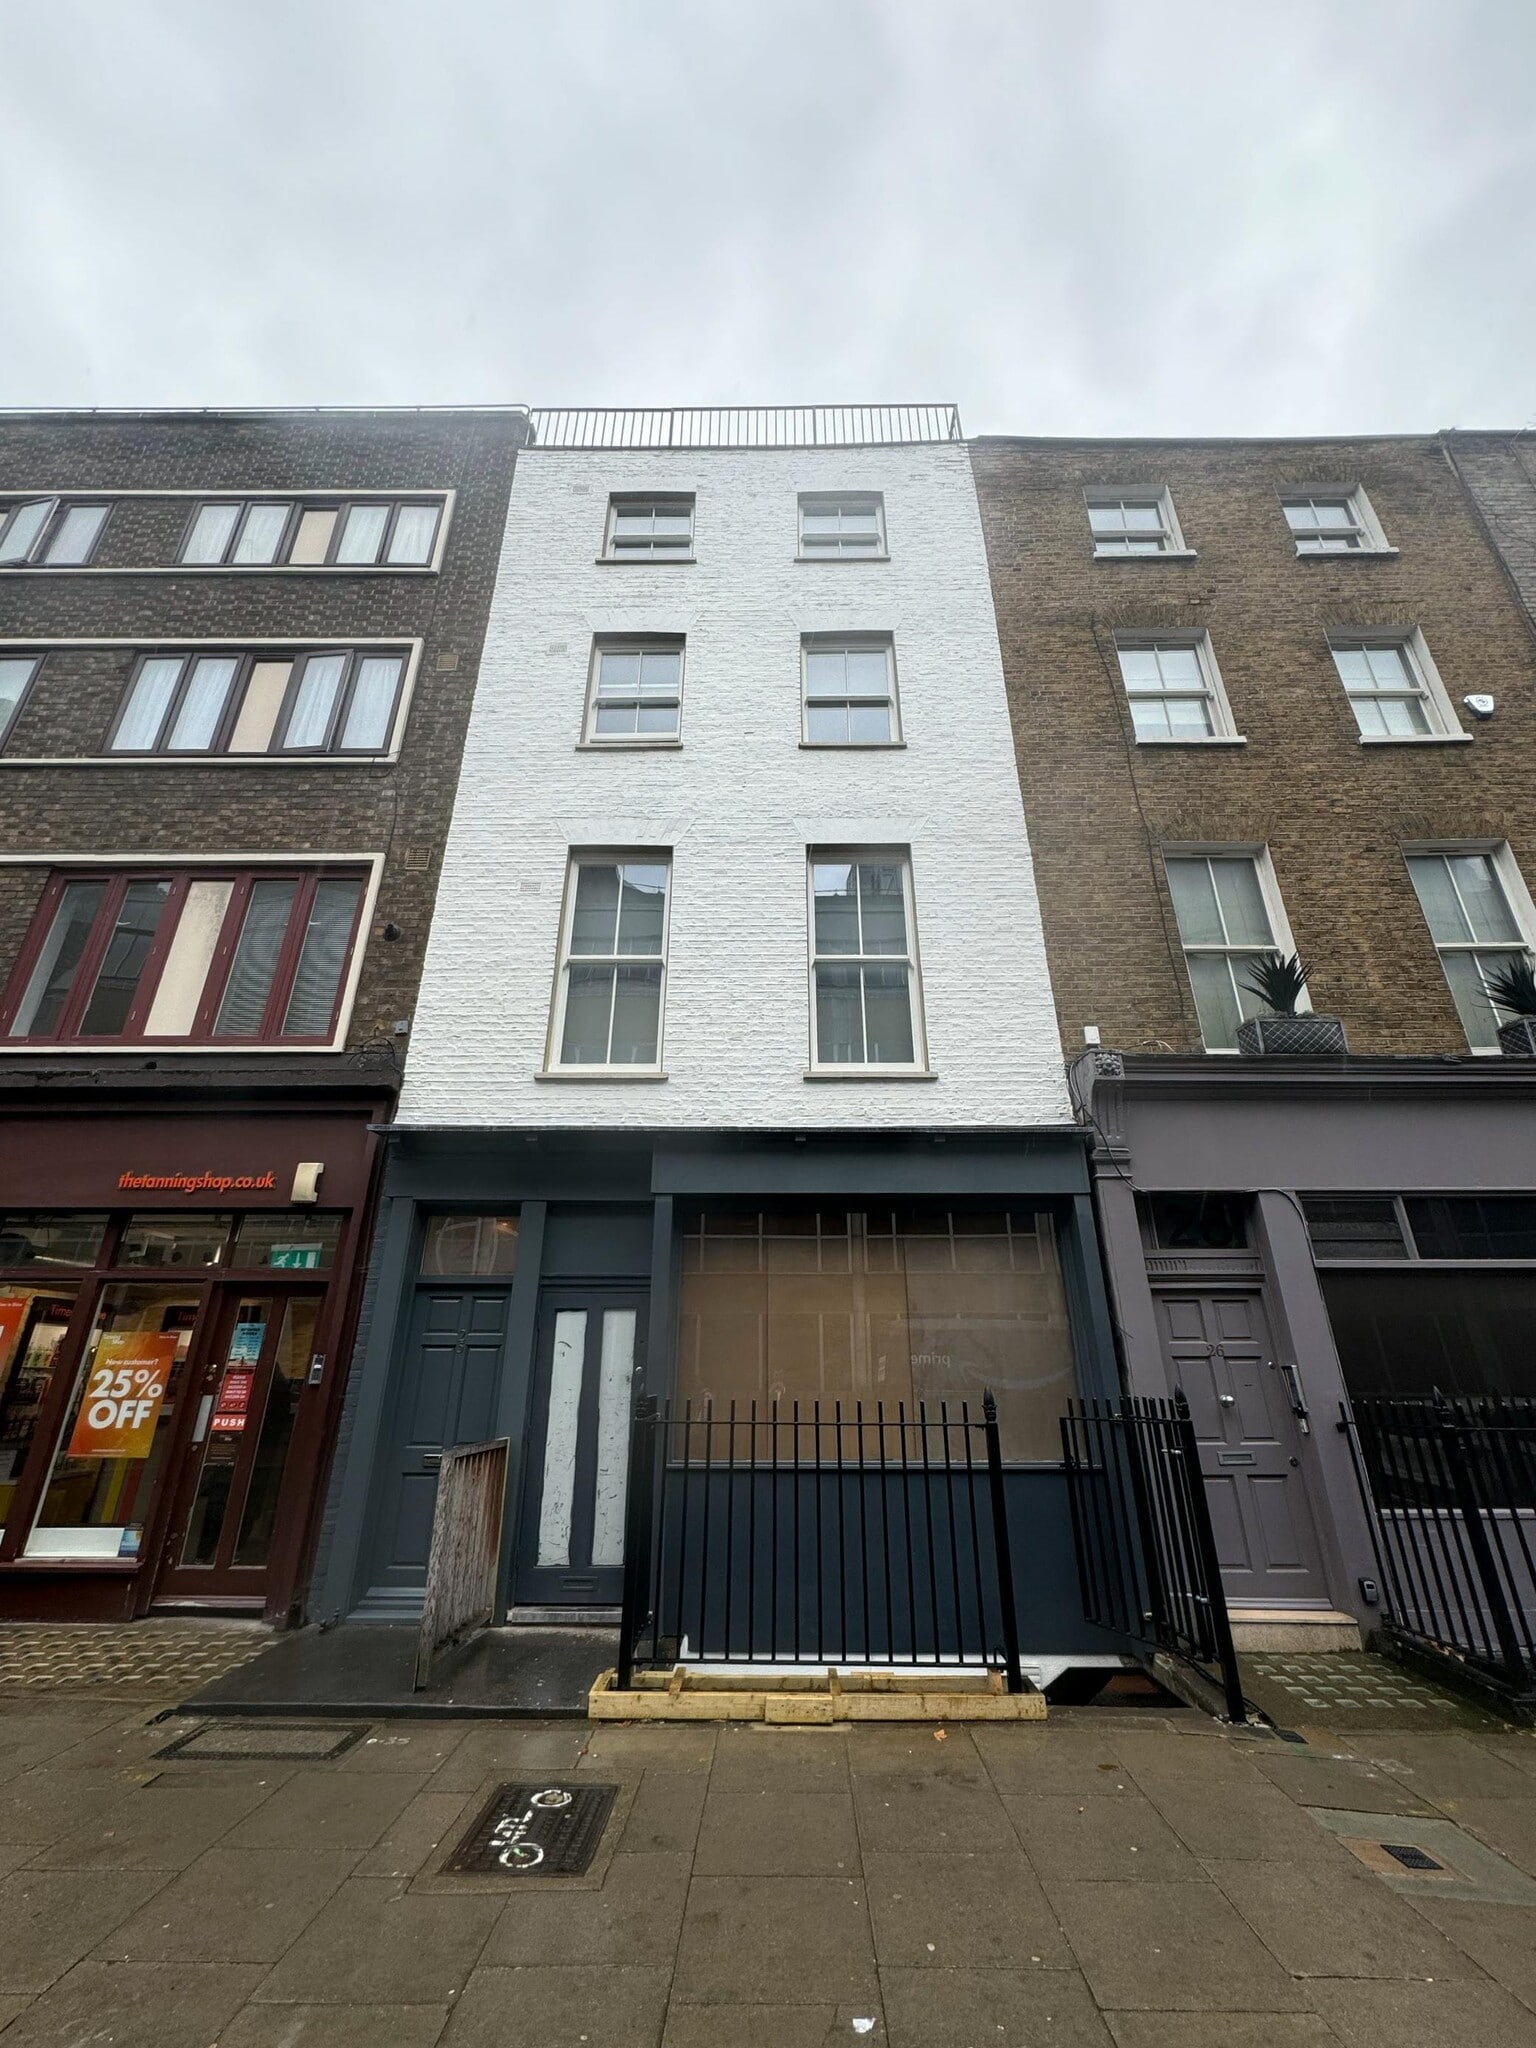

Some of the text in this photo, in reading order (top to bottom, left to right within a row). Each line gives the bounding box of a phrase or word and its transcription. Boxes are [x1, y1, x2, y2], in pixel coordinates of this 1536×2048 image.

[118, 1171, 275, 1193] thetanningshop.co.uk
[1207, 1343, 1224, 1357] 26
[88, 1369, 163, 1398] 25%
[88, 1399, 154, 1429] OFF
[213, 1418, 246, 1427] PUSH
